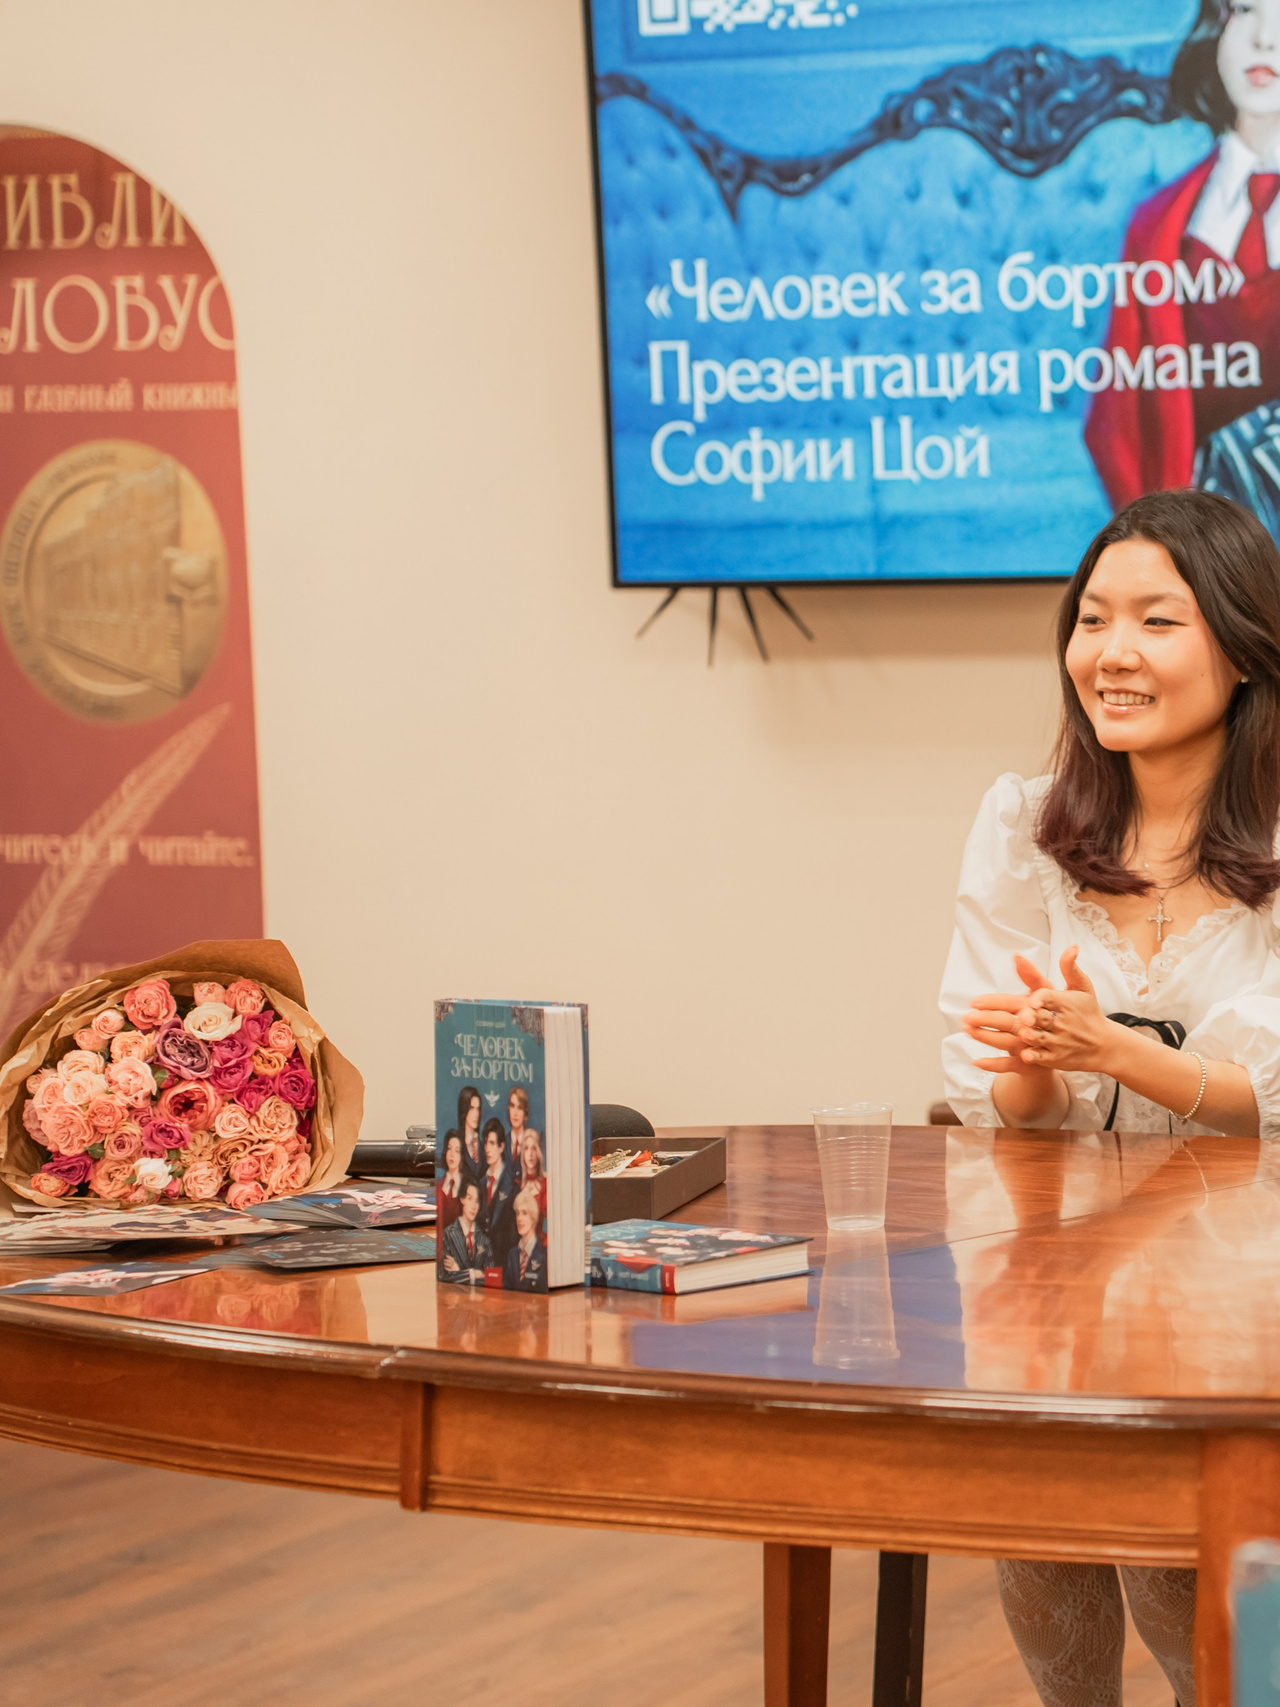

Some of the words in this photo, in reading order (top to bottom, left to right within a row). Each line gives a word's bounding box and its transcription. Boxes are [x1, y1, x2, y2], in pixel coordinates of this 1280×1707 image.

[645, 258, 906, 322] «Человек
[919, 270, 982, 313] за
[998, 251, 1246, 328] бортом»
[648, 340, 1021, 423] Презентация
[1039, 342, 1262, 412] романа
[650, 420, 855, 502] Софии
[871, 416, 992, 483] Цой
[454, 1033, 526, 1061] ЧЕЛОВЕК
[472, 1058, 534, 1083] БОРТОМ
